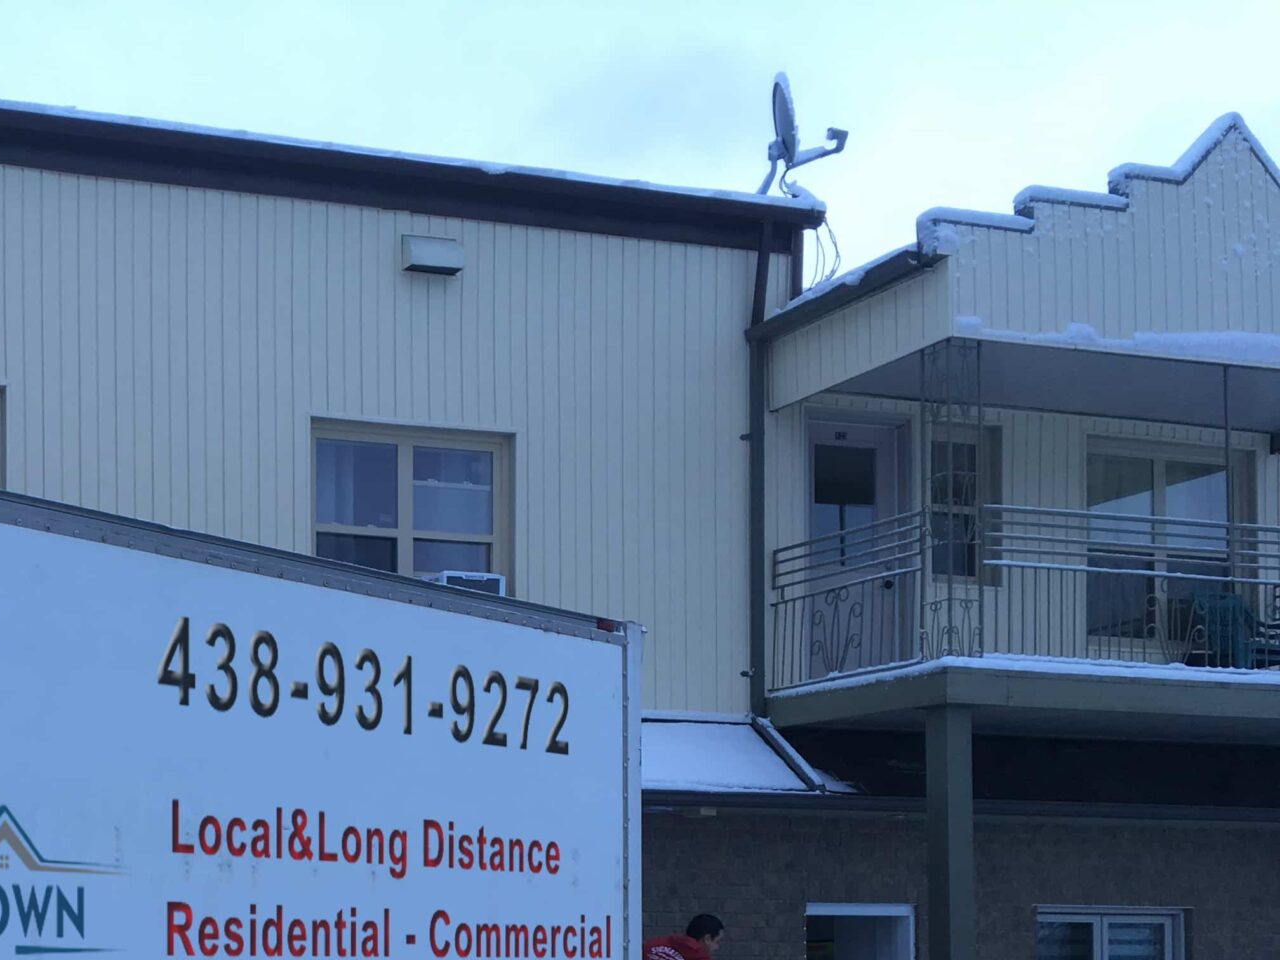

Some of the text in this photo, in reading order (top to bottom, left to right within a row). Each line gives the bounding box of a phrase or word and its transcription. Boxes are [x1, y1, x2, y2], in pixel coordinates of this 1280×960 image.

[158, 616, 571, 756] 438-931-9272
[171, 798, 561, 881] Local&Long Distance
[166, 901, 390, 958] Residential
[428, 909, 612, 960] Commercial
